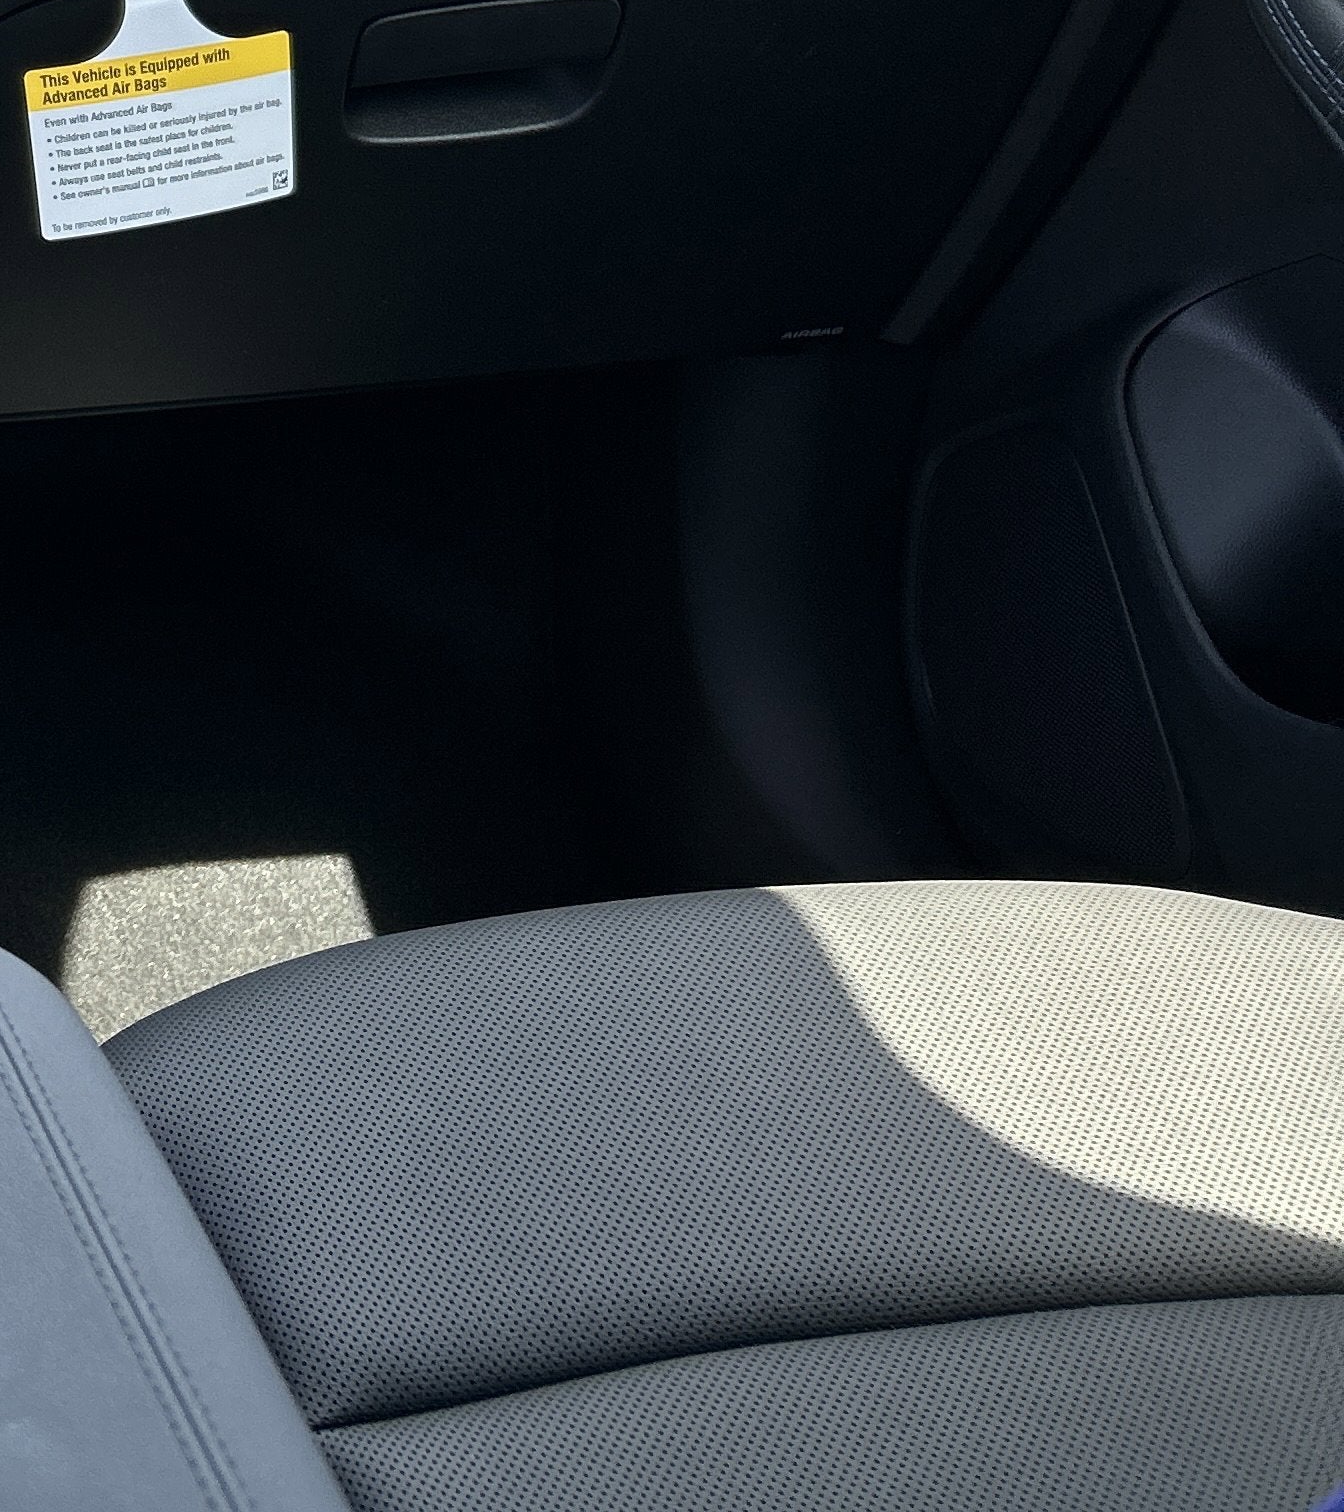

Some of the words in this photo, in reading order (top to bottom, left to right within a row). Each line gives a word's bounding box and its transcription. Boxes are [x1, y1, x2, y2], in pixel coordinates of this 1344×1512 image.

[40, 73, 70, 88] This
[72, 66, 121, 84] Vehicle
[140, 52, 199, 75] Equipped
[203, 48, 230, 64] with
[42, 84, 108, 105] Advanced
[112, 80, 131, 95] Air
[135, 77, 167, 92] Bags
[44, 117, 67, 129] Even
[69, 113, 89, 125] with
[91, 107, 134, 122] Advanced
[136, 104, 149, 115] Air
[151, 102, 172, 113] Bags
[54, 132, 90, 145] Children
[92, 130, 109, 139] can
[110, 127, 121, 136] be
[160, 115, 197, 129] seriously
[228, 107, 238, 117] by
[56, 149, 71, 159] The
[73, 145, 93, 156] back
[124, 138, 137, 147] the
[139, 133, 164, 145] safest
[165, 131, 186, 142] place
[188, 128, 198, 137] for
[57, 162, 81, 173] Never
[83, 159, 97, 170] put
[106, 150, 151, 166] rear-facing
[152, 147, 172, 158] child
[126, 167, 146, 177] belts
[147, 163, 163, 173] and
[164, 159, 183, 170] child
[60, 191, 76, 201] See
[77, 186, 110, 199] owner's
[157, 176, 168, 185] for
[52, 224, 61, 233] To
[63, 222, 73, 231] be
[74, 217, 108, 229] removed
[109, 215, 118, 226] by
[119, 209, 154, 223] customer
